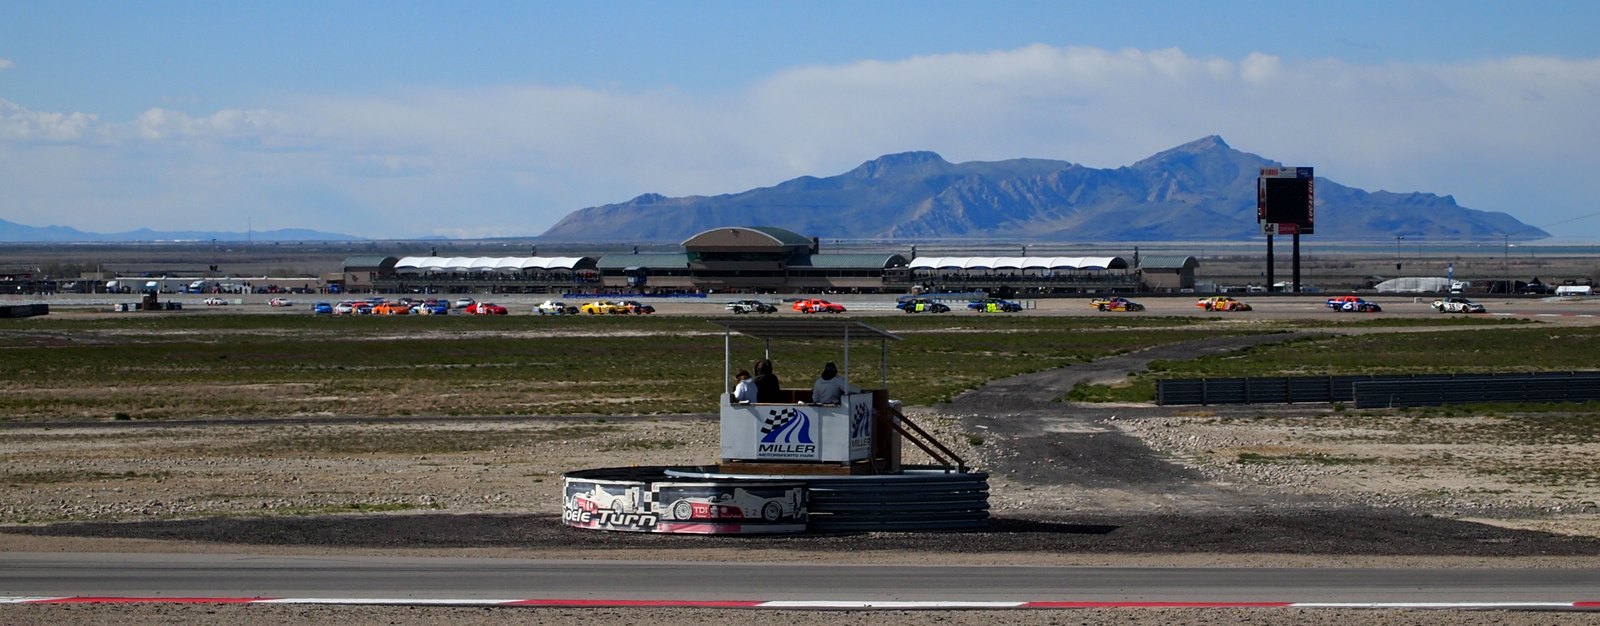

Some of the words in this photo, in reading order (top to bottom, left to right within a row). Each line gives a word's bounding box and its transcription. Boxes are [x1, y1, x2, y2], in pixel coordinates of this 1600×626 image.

[1342, 302, 1352, 310] 6
[758, 444, 816, 453] MILLER
[693, 506, 708, 514] TDI
[564, 507, 591, 523] oele
[598, 509, 657, 526] Turn
